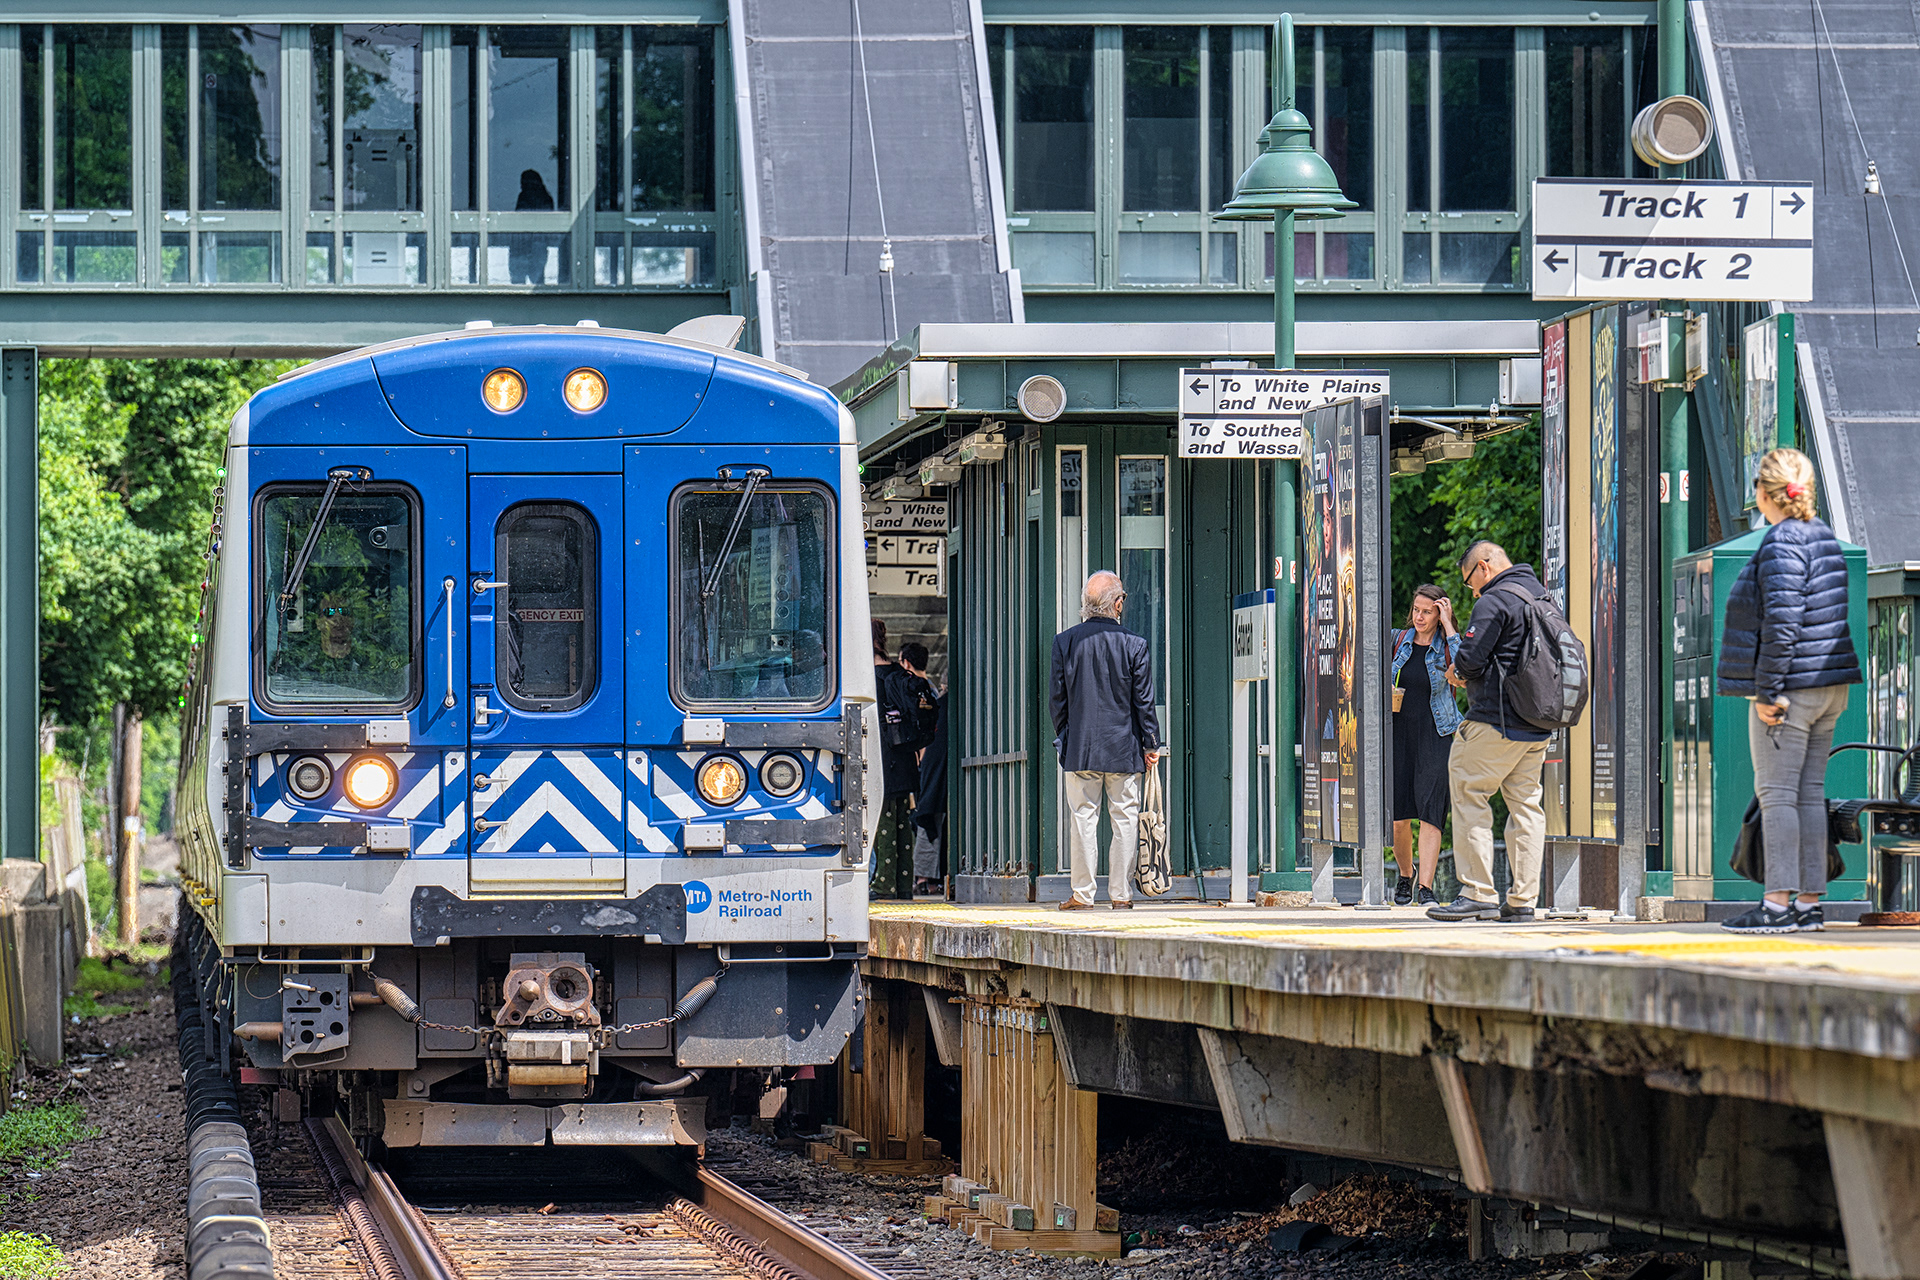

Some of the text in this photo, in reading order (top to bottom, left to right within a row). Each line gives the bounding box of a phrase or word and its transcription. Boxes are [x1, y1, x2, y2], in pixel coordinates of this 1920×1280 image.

[1599, 190, 1749, 218] Track 1
[1598, 251, 1752, 279] Track 2
[1219, 379, 1381, 393] To White Plains
[1219, 397, 1256, 410] and
[1267, 396, 1311, 410] New
[1189, 423, 1301, 437] To Southea
[1188, 441, 1301, 454] and Wassa
[883, 504, 945, 514] o White
[875, 517, 946, 527] and New
[906, 539, 937, 554] Tra
[905, 571, 937, 585] Tra
[519, 611, 583, 620] GENCY EXIT
[684, 890, 706, 905] MTA
[719, 890, 812, 902] Metro-North
[719, 905, 782, 917] Railroad
